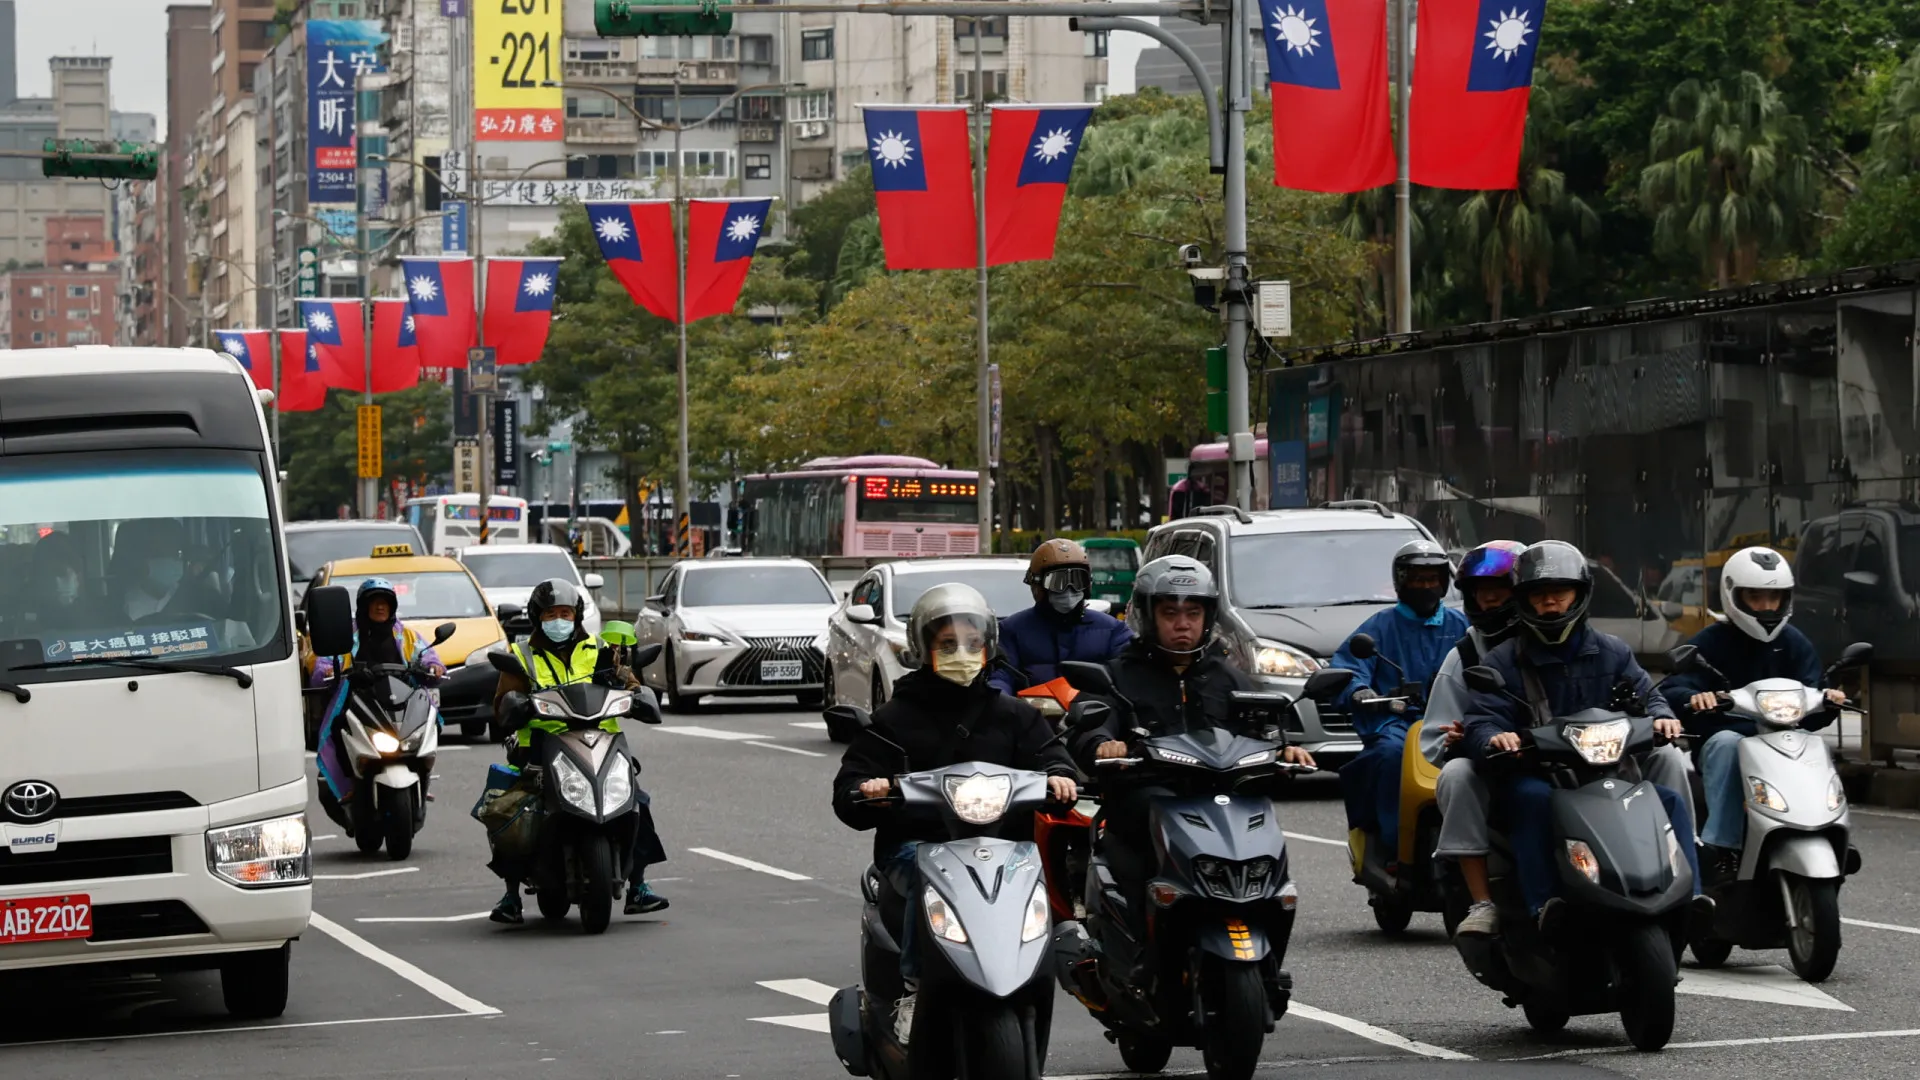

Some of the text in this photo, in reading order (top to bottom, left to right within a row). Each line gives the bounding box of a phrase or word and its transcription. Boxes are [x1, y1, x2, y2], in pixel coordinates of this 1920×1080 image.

[490, 31, 549, 88] -221
[480, 113, 557, 135] 弘力廣告
[376, 545, 409, 555] TAXI
